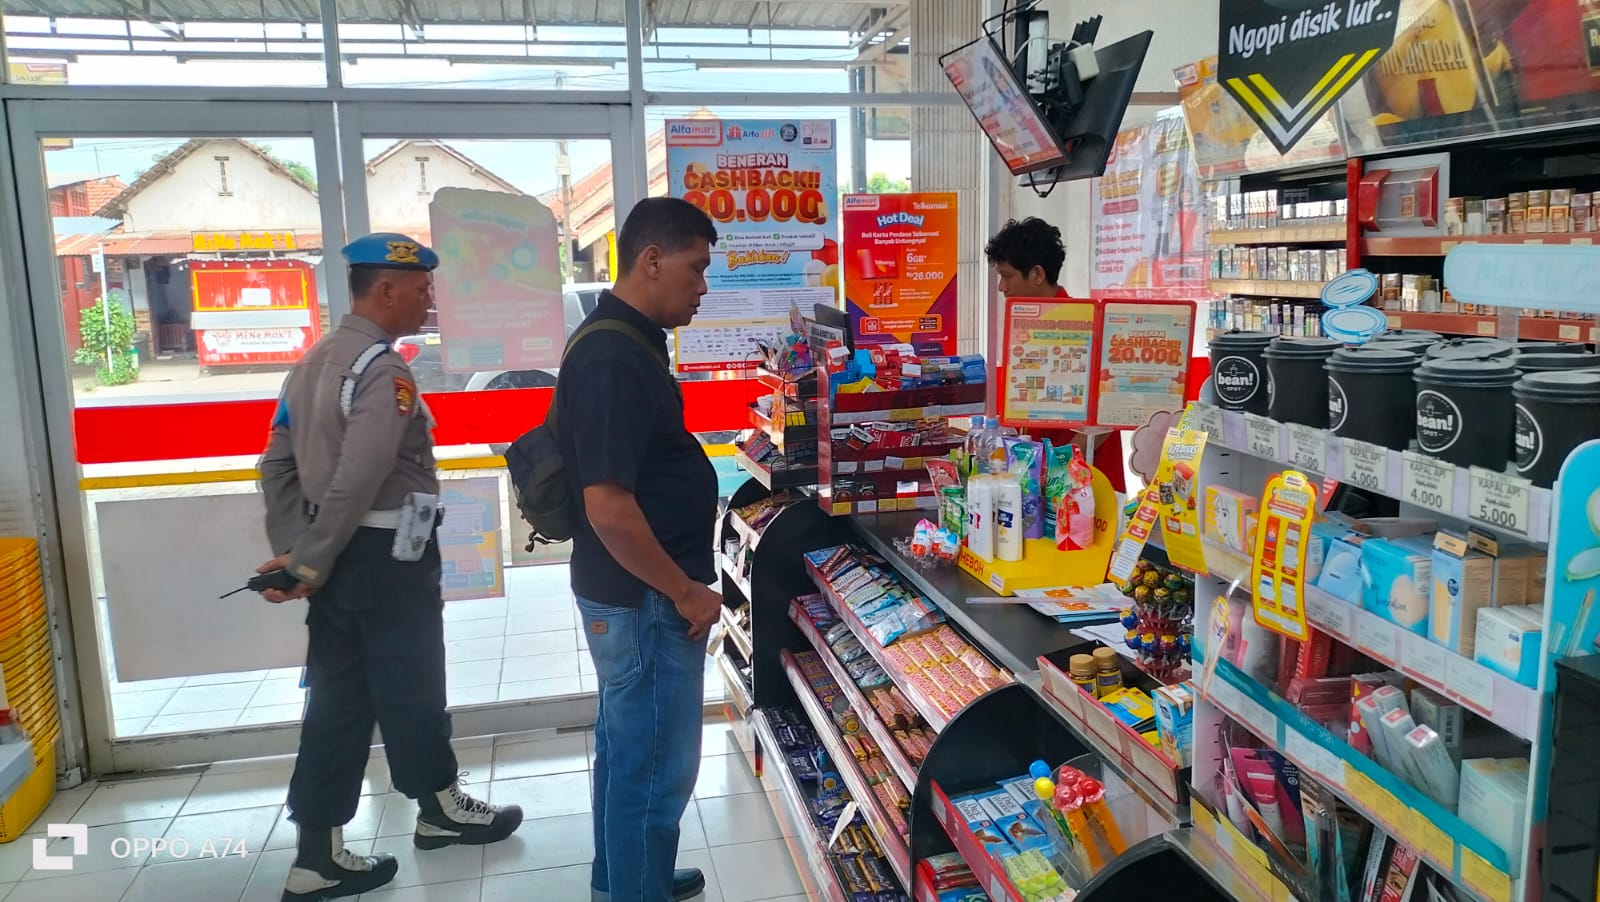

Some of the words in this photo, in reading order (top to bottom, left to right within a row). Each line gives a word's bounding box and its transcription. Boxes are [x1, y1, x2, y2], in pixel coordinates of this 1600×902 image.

[1229, 15, 1287, 58] Ngopi
[1290, 2, 1342, 41] disik
[670, 124, 716, 135] Alfamart
[717, 154, 789, 169] BENERAN
[683, 170, 821, 189] CASHBACK!!
[877, 213, 900, 228] Hot
[900, 212, 924, 227] Deal
[1110, 338, 1182, 349] CASHBACK!!
[1108, 347, 1183, 366] 20.000
[1218, 372, 1253, 386] bean!
[1350, 470, 1379, 489] 4.000
[1479, 479, 1505, 494] KAPAL
[1410, 488, 1443, 509] 4.000
[1479, 504, 1517, 528] 5.000
[960, 550, 985, 576] HEBOH
